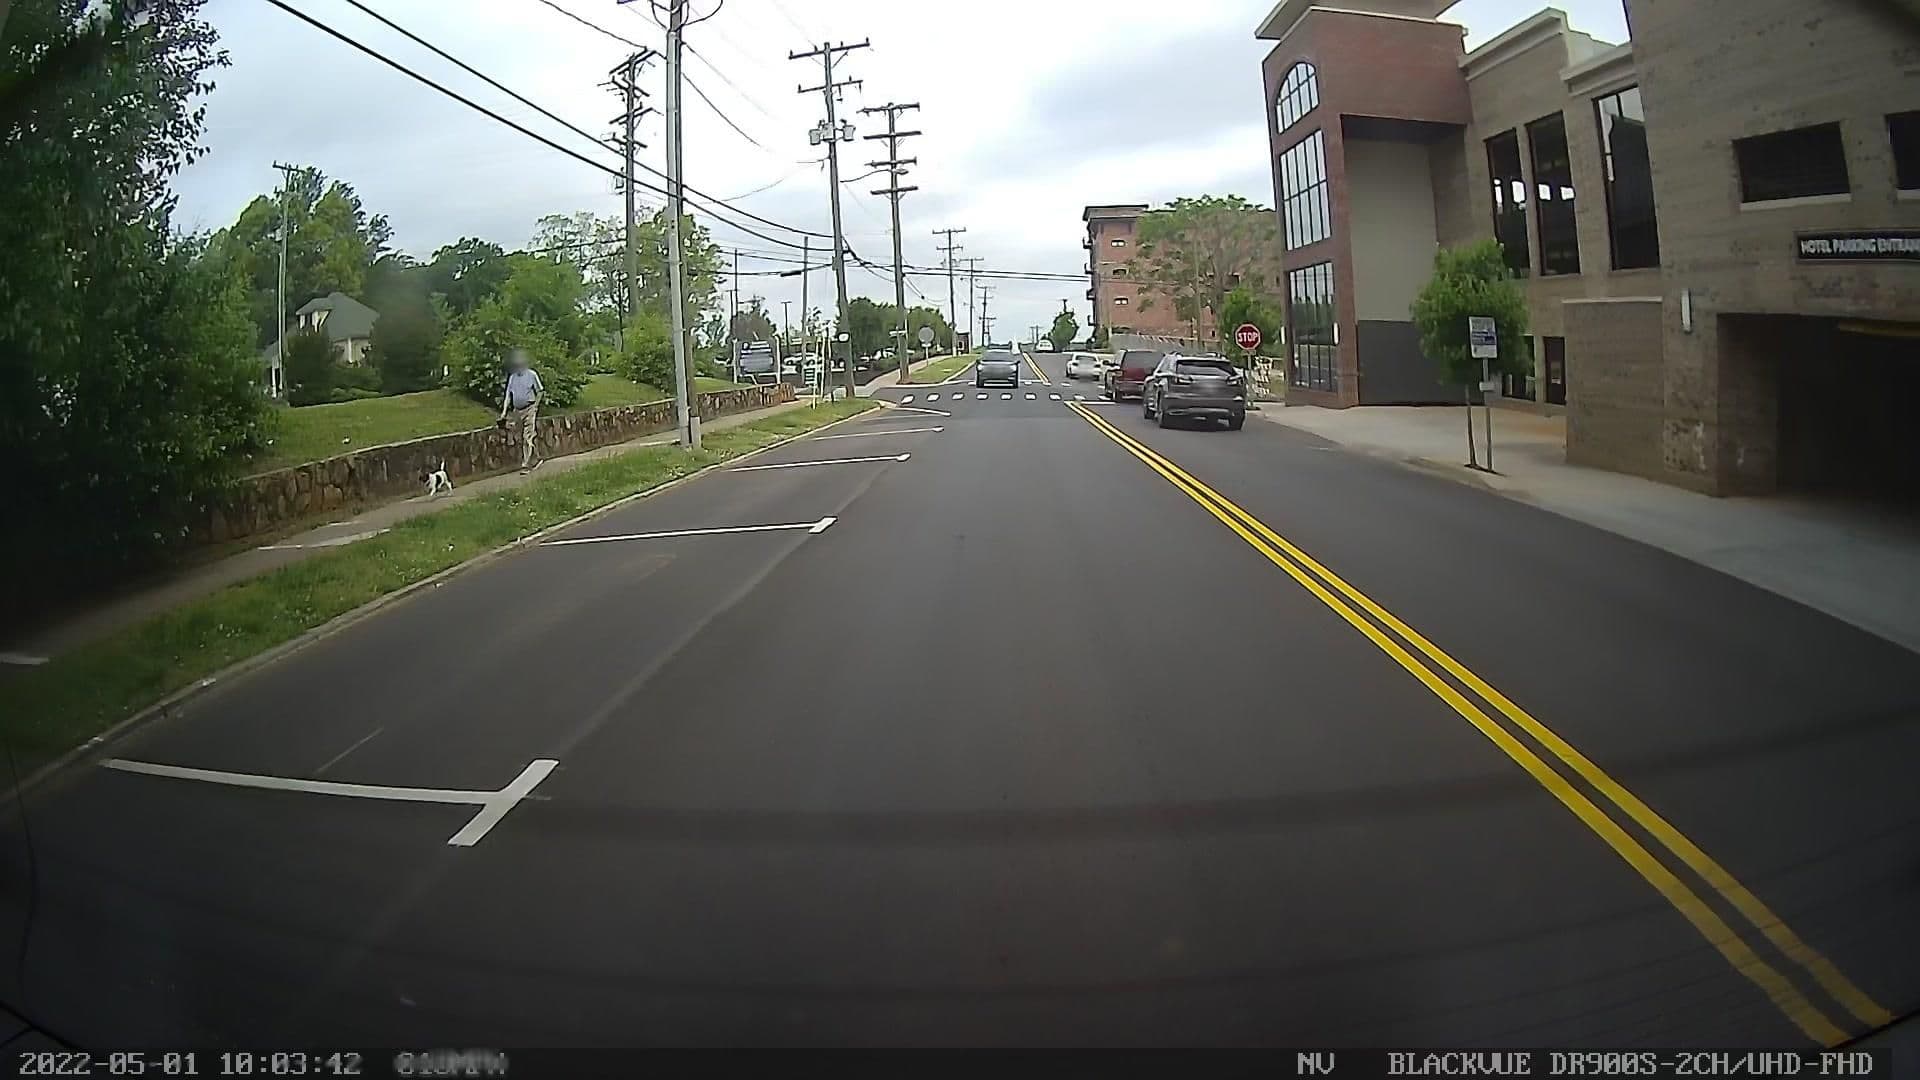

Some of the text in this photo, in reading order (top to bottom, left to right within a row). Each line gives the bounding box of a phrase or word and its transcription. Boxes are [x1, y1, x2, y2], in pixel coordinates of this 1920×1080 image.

[1800, 238, 1920, 254] HOTEL PARKING ENTRAN
[1238, 332, 1258, 342] STOP
